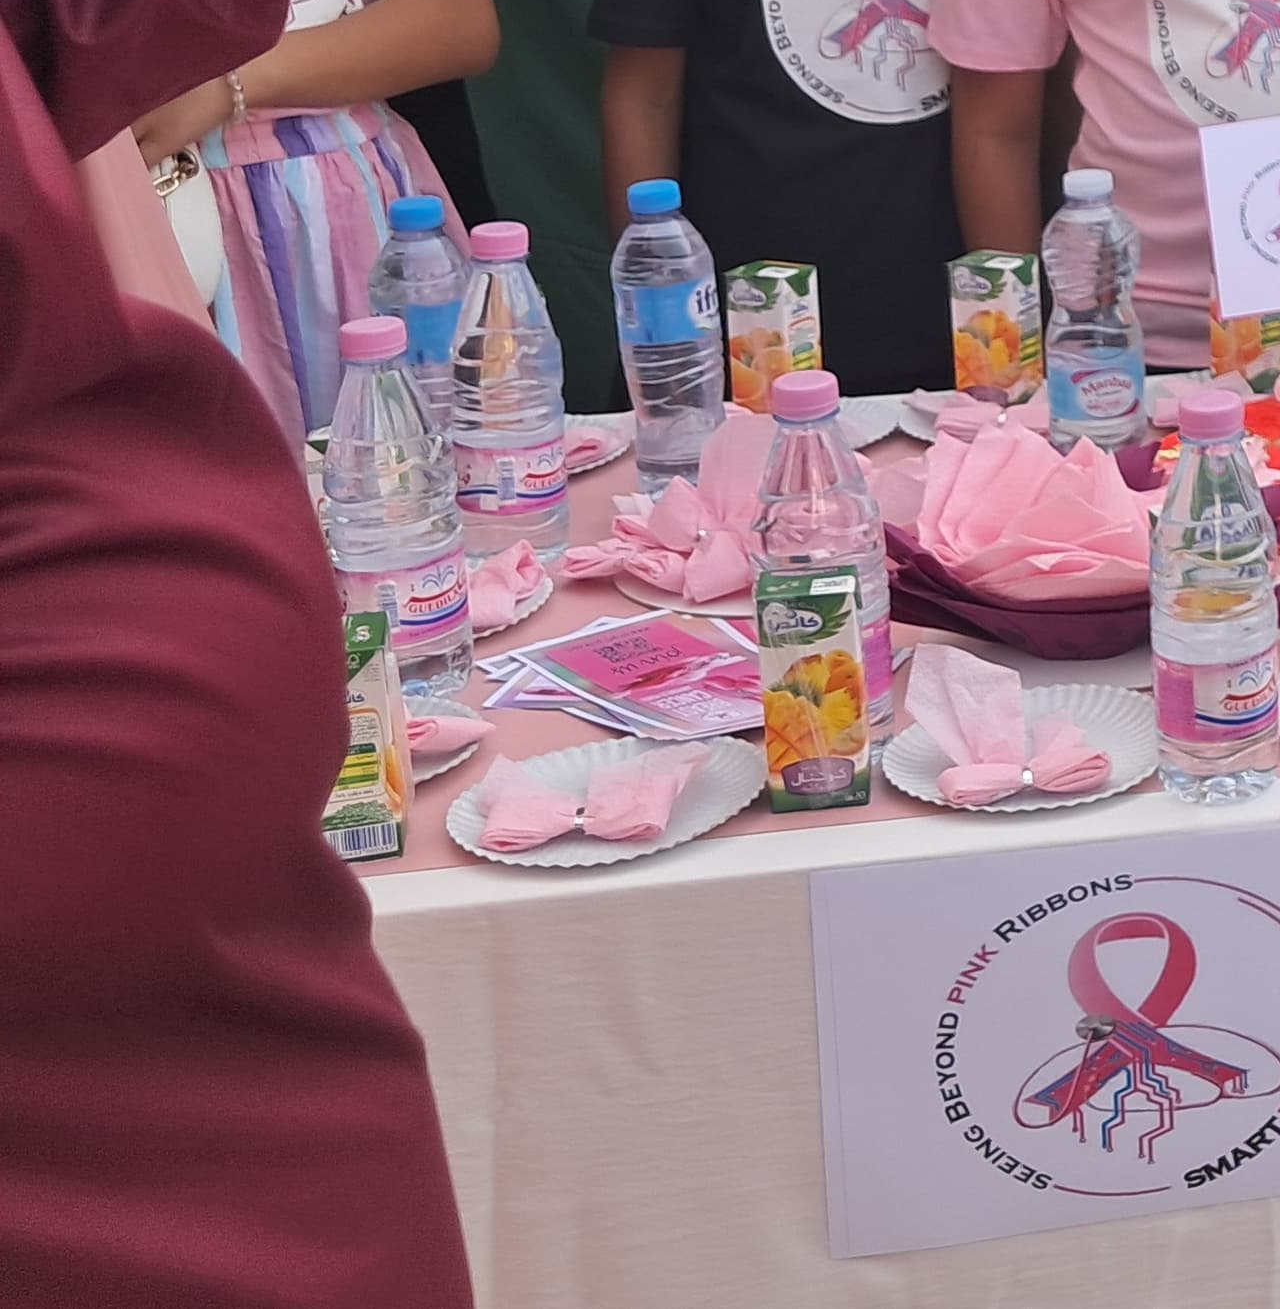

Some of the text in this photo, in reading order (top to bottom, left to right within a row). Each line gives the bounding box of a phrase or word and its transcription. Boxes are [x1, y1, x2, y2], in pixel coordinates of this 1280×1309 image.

[935, 873, 1134, 1190] SEEING BEYOND PINK RIBBONS
